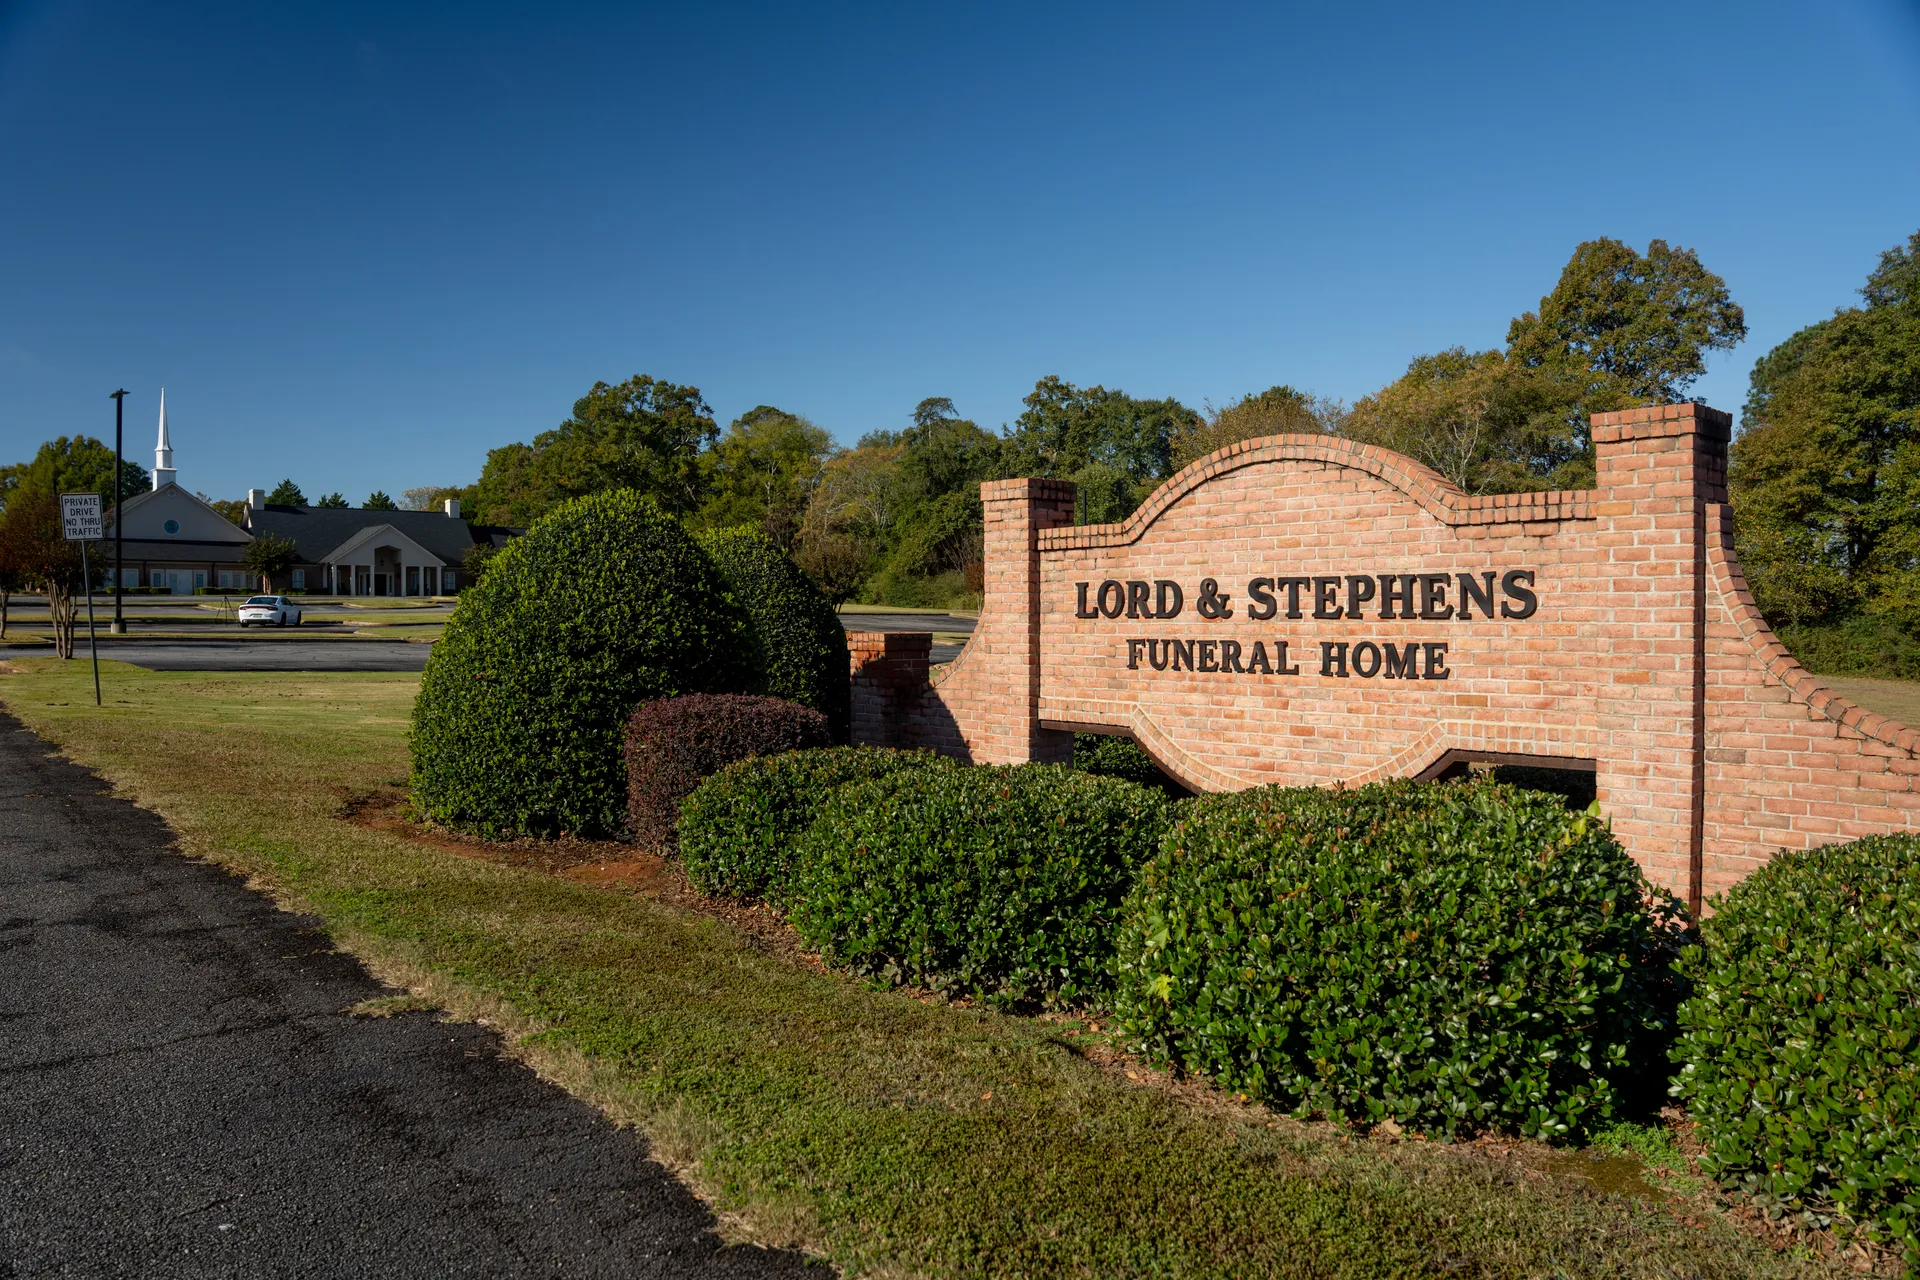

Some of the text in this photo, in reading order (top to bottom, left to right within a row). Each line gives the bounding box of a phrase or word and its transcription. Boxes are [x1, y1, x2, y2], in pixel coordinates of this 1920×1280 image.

[64, 498, 98, 506] PRIVATE
[70, 508, 94, 516] DRIVE
[66, 518, 100, 526] NO THRU
[67, 527, 100, 536] TRAFFIC
[1074, 570, 1537, 621] LORD & STEPHENS
[1126, 637, 1451, 681] FUNERAL HOME
